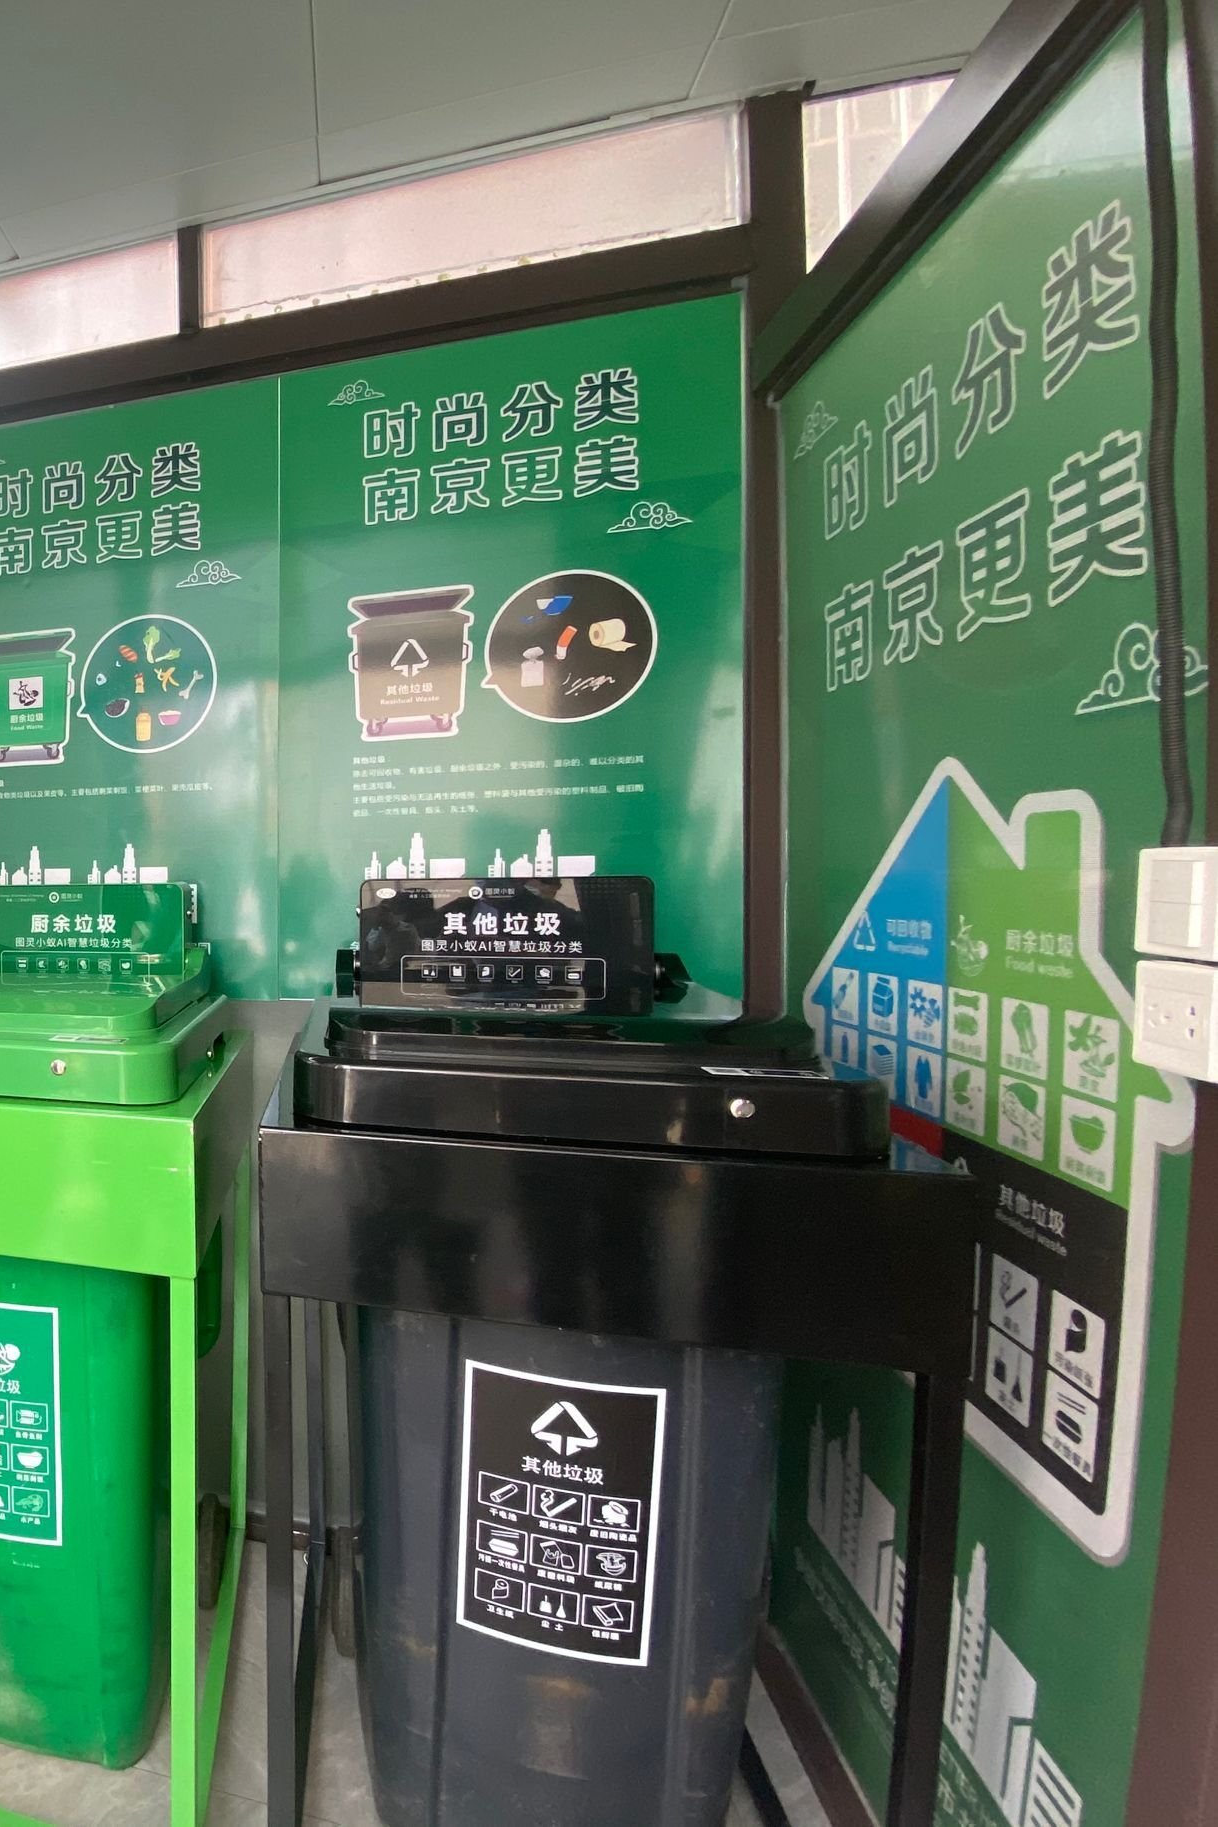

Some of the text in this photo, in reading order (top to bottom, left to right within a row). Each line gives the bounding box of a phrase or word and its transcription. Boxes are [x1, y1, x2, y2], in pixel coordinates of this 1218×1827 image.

[823, 199, 1140, 540] 时尚分类
[363, 367, 639, 458] 时尚分类
[362, 435, 639, 525] 南京更美
[825, 429, 1148, 693] 南京更美
[386, 681, 433, 696] 其他垃圾
[30, 914, 117, 934] 厨余垃圾
[443, 912, 561, 937] 其他垃圾
[15, 936, 133, 949] 图灵小蚁AI智慧垃圾分类
[420, 939, 583, 954] 图灵小蚁AI智慧垃圾分类
[1005, 928, 1075, 958] 厨余垃圾
[521, 1455, 603, 1485] 其他垃圾
[489, 1507, 517, 1521] 干电池
[538, 1519, 577, 1534] 烟头烟灰
[589, 1529, 637, 1542] 废旧陶瓷品
[486, 1604, 514, 1619] 卫生纸
[541, 1619, 563, 1631] 尘土
[591, 1629, 619, 1640] 保鲜膜
